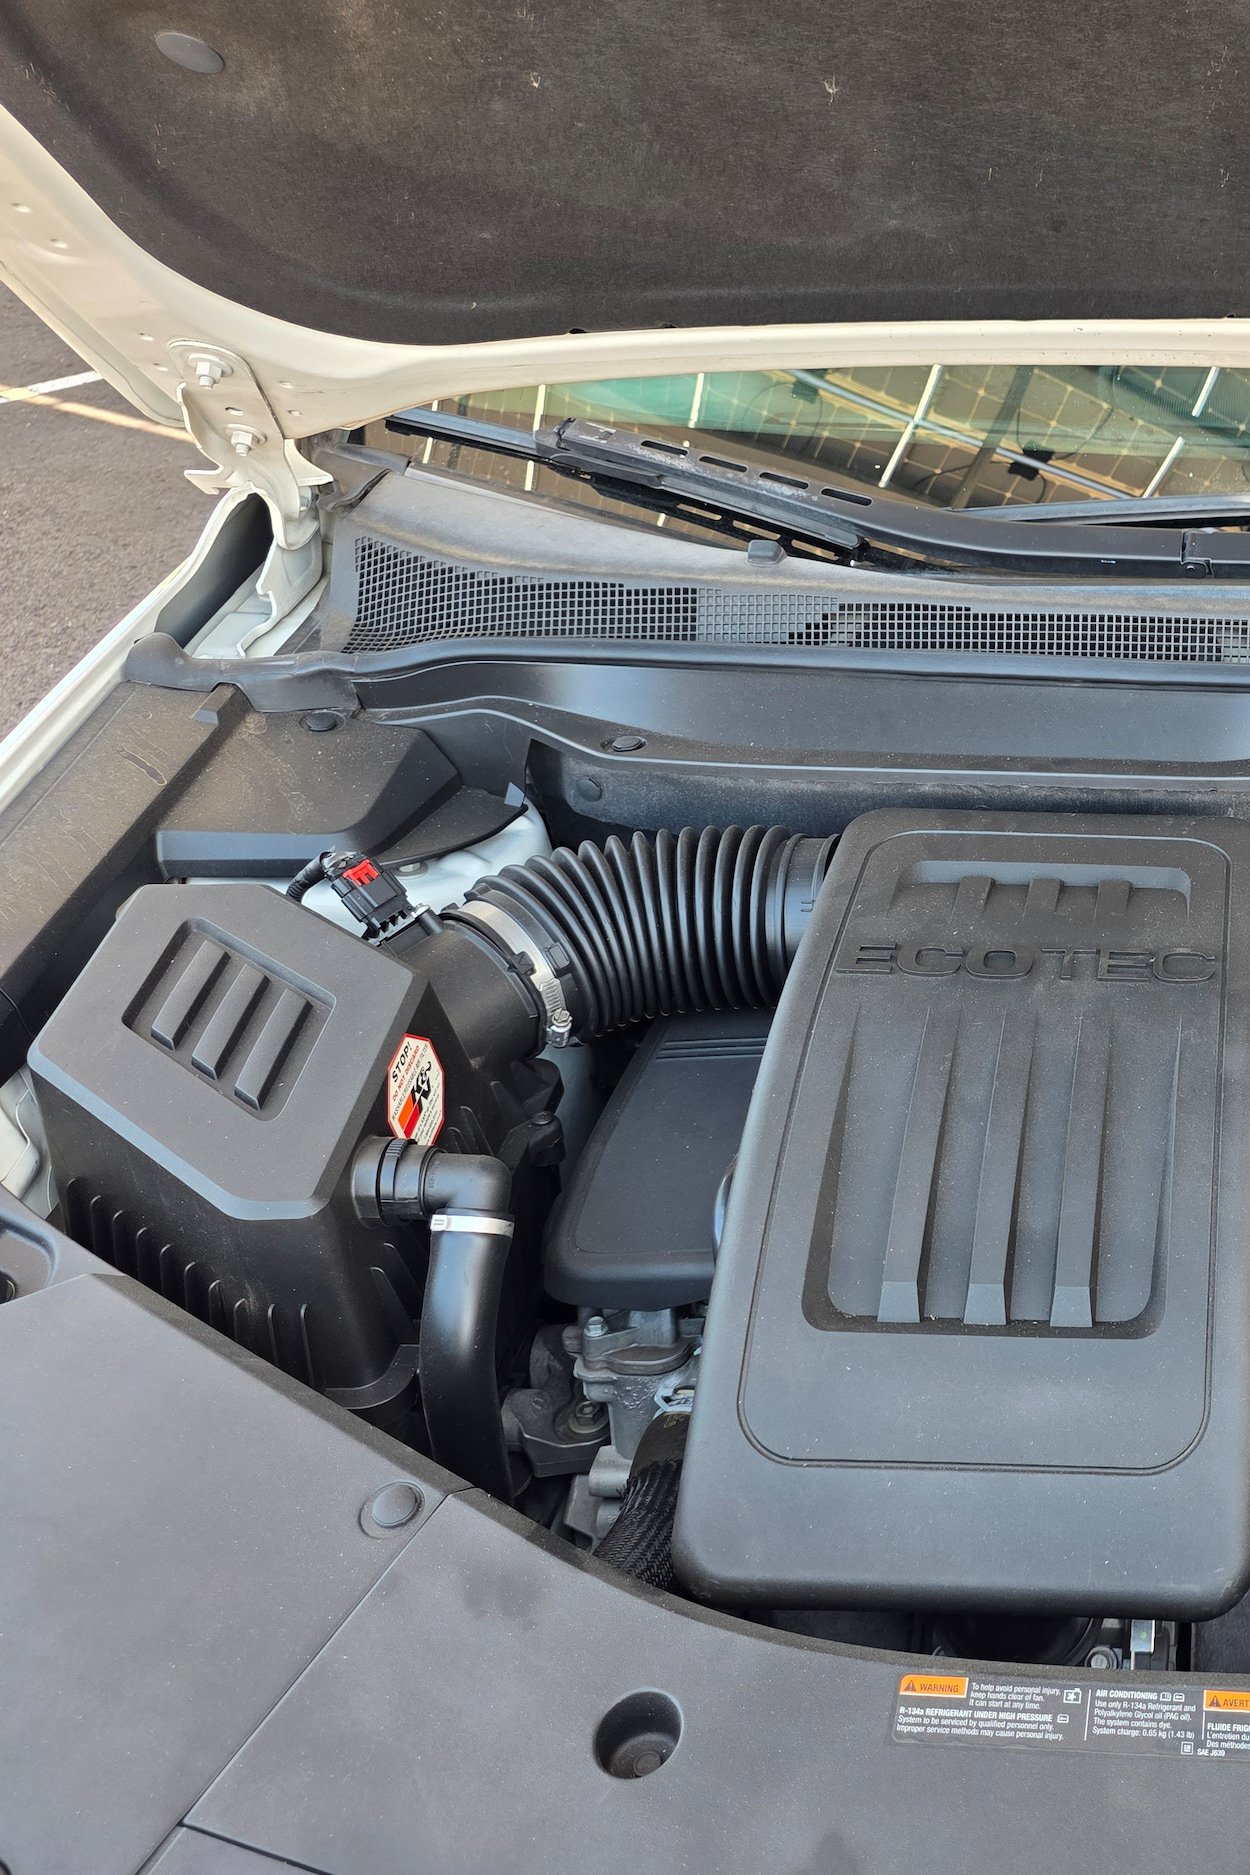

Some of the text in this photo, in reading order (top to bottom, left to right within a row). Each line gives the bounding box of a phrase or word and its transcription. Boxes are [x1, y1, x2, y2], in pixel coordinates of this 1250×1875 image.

[835, 942, 1216, 982] ECOTEC
[392, 1041, 412, 1082] STOP!
[393, 1091, 398, 1101] DO
[405, 1045, 420, 1075] DISCARD
[920, 1683, 959, 1693] WARNING
[980, 1683, 993, 1692] help
[1014, 1685, 1040, 1694] personal
[970, 1691, 985, 1699] keep
[1109, 1691, 1157, 1699] CONDITIONING
[1012, 1702, 1024, 1710] any
[1025, 1702, 1041, 1710] time.
[1095, 1700, 1107, 1708] Use
[1148, 1703, 1182, 1712] Refrigerant
[900, 1706, 1052, 1722] R-134a REFRIGERANT UNDER HIGH PRESSURE
[1094, 1709, 1132, 1718] Polyalkylene
[1135, 1710, 1153, 1719] Glycol
[1164, 1712, 1178, 1721] (PAG
[1180, 1713, 1191, 1721] oil).
[898, 1715, 921, 1724] System
[941, 1718, 967, 1726] serviced
[969, 1719, 976, 1728] by
[979, 1720, 1005, 1729] qualified
[1007, 1722, 1038, 1730] personnel
[1040, 1723, 1054, 1731] only.
[1094, 1717, 1172, 1729] The system contains dye.
[1208, 1723, 1232, 1731] FLUIDE
[897, 1724, 1064, 1741] Improper service methods may cause personal injury.
[1093, 1726, 1116, 1735] System
[1117, 1728, 1141, 1737] charge:
[1158, 1730, 1166, 1738] kg
[1207, 1732, 1240, 1741] L'entretien
[1207, 1740, 1218, 1748] Des
[1220, 1741, 1250, 1749] méthodes
[1197, 1748, 1209, 1756] SAE
